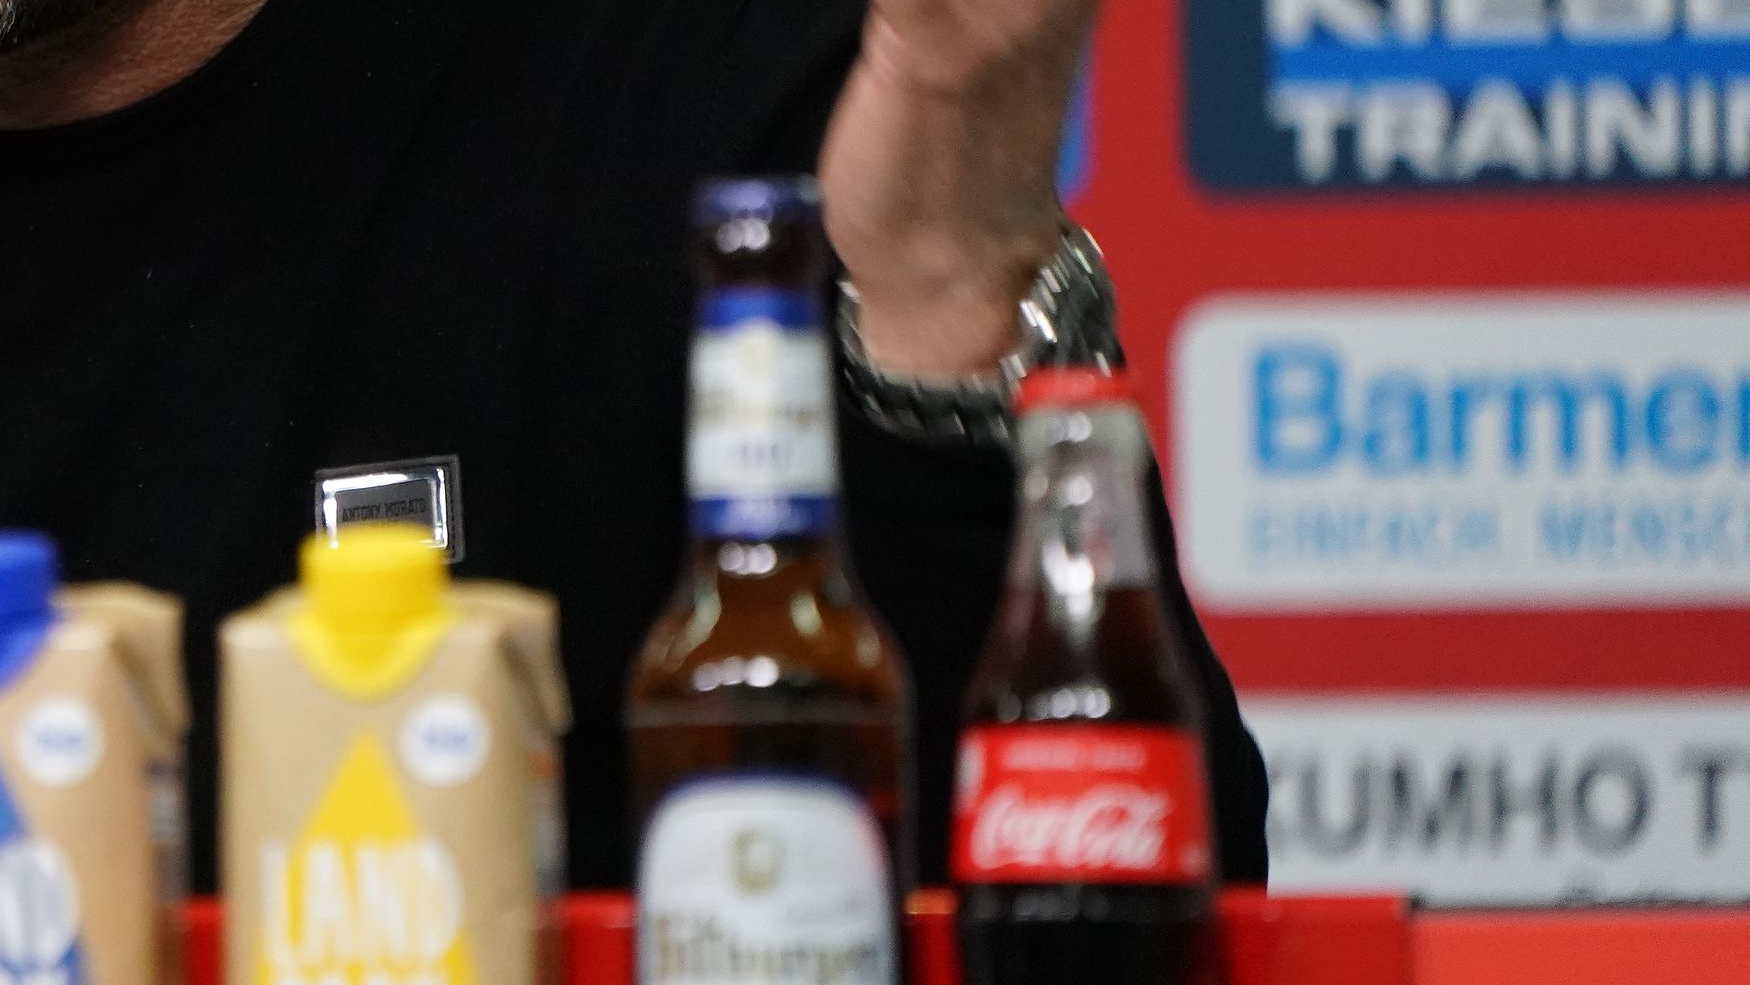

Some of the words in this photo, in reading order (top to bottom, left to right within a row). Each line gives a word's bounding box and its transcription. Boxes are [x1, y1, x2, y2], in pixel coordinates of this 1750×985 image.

[1263, 76, 1750, 184] TRAINI
[1250, 342, 1750, 474] Barme
[972, 784, 1170, 870] Coca-Cola
[258, 836, 466, 962] LAND
